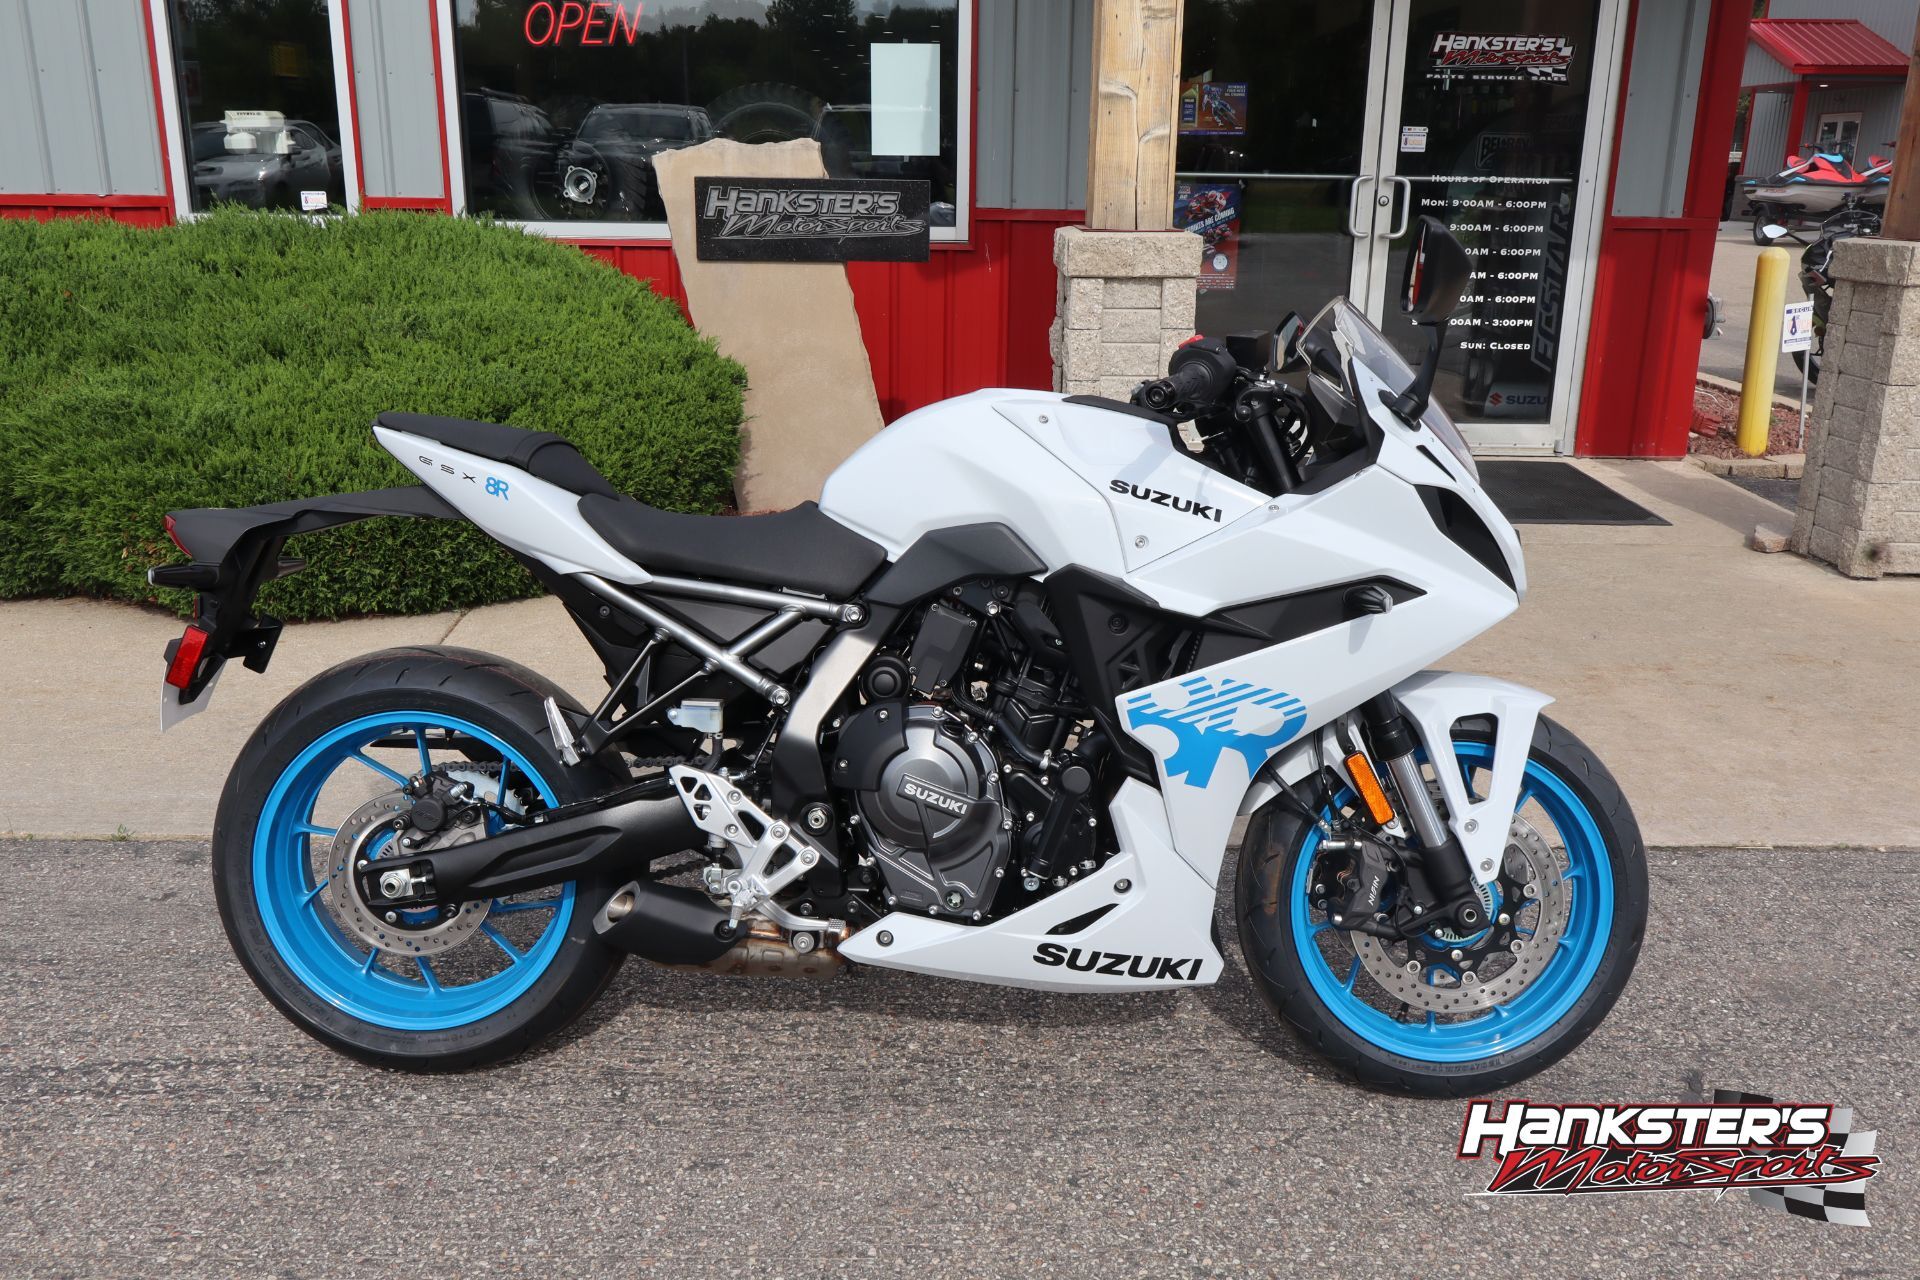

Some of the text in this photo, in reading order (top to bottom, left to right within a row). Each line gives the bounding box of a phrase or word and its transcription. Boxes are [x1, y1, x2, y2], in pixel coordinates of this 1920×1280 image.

[525, 1, 643, 45] OPEN
[1432, 174, 1468, 183] HOURS
[1489, 175, 1550, 185] OPERATION
[1452, 199, 1494, 208] 9:00AM
[1505, 200, 1547, 209] 6:00PM
[1449, 223, 1491, 232] 9:00AM
[1502, 224, 1544, 233] 6:00PM
[1464, 247, 1489, 256] 0AM
[1500, 248, 1541, 257] 6:00PM
[1497, 271, 1539, 280] 6:00PM
[1459, 295, 1484, 303] 0AM
[1494, 295, 1536, 304] 6:00PM
[1492, 318, 1533, 327] 3:00PM
[418, 455, 509, 501] GSX 8R
[1109, 479, 1222, 523] SUZUKI
[904, 783, 968, 815] SUZUKI
[1033, 943, 1203, 981] SUZUKI
